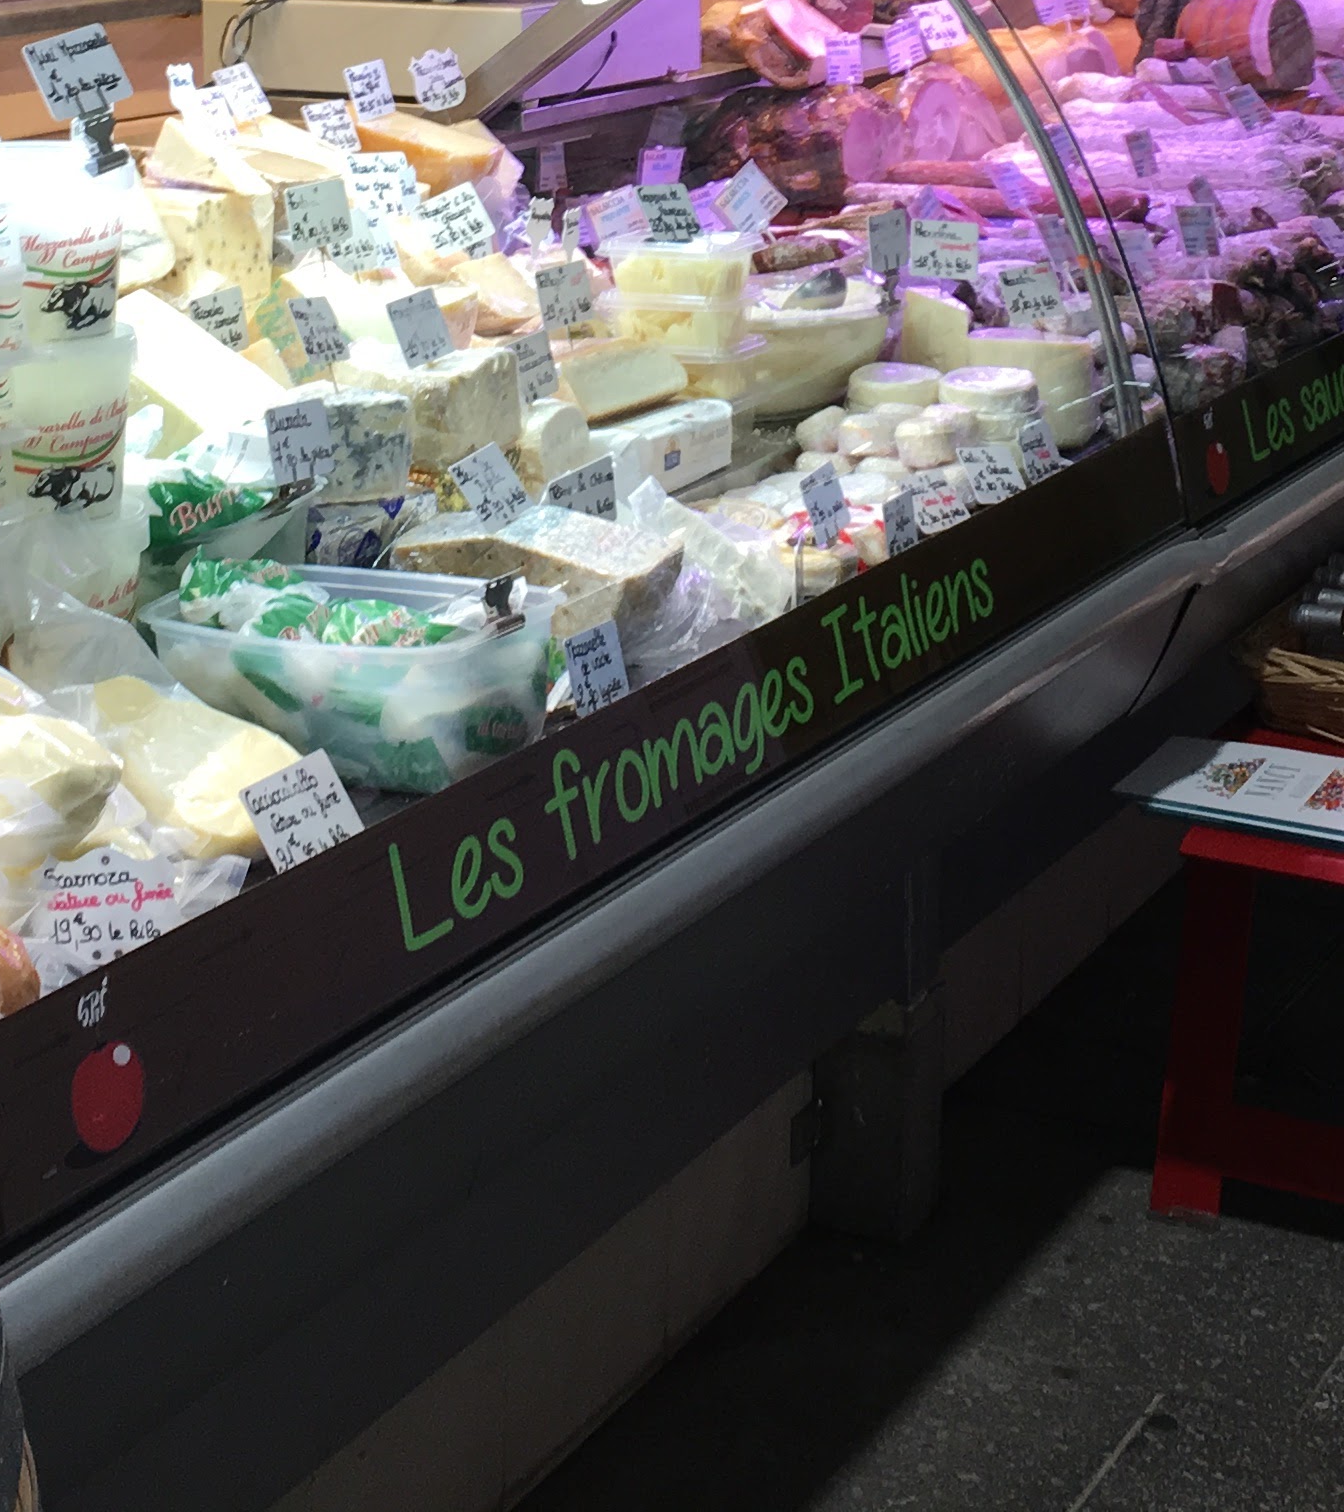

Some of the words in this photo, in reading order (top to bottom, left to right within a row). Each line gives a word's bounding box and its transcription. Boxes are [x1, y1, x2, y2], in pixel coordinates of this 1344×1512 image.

[1242, 397, 1296, 462] Les
[389, 819, 525, 952] Les
[545, 655, 816, 861] fromages
[821, 558, 995, 706] Italiens
[108, 919, 125, 941] le
